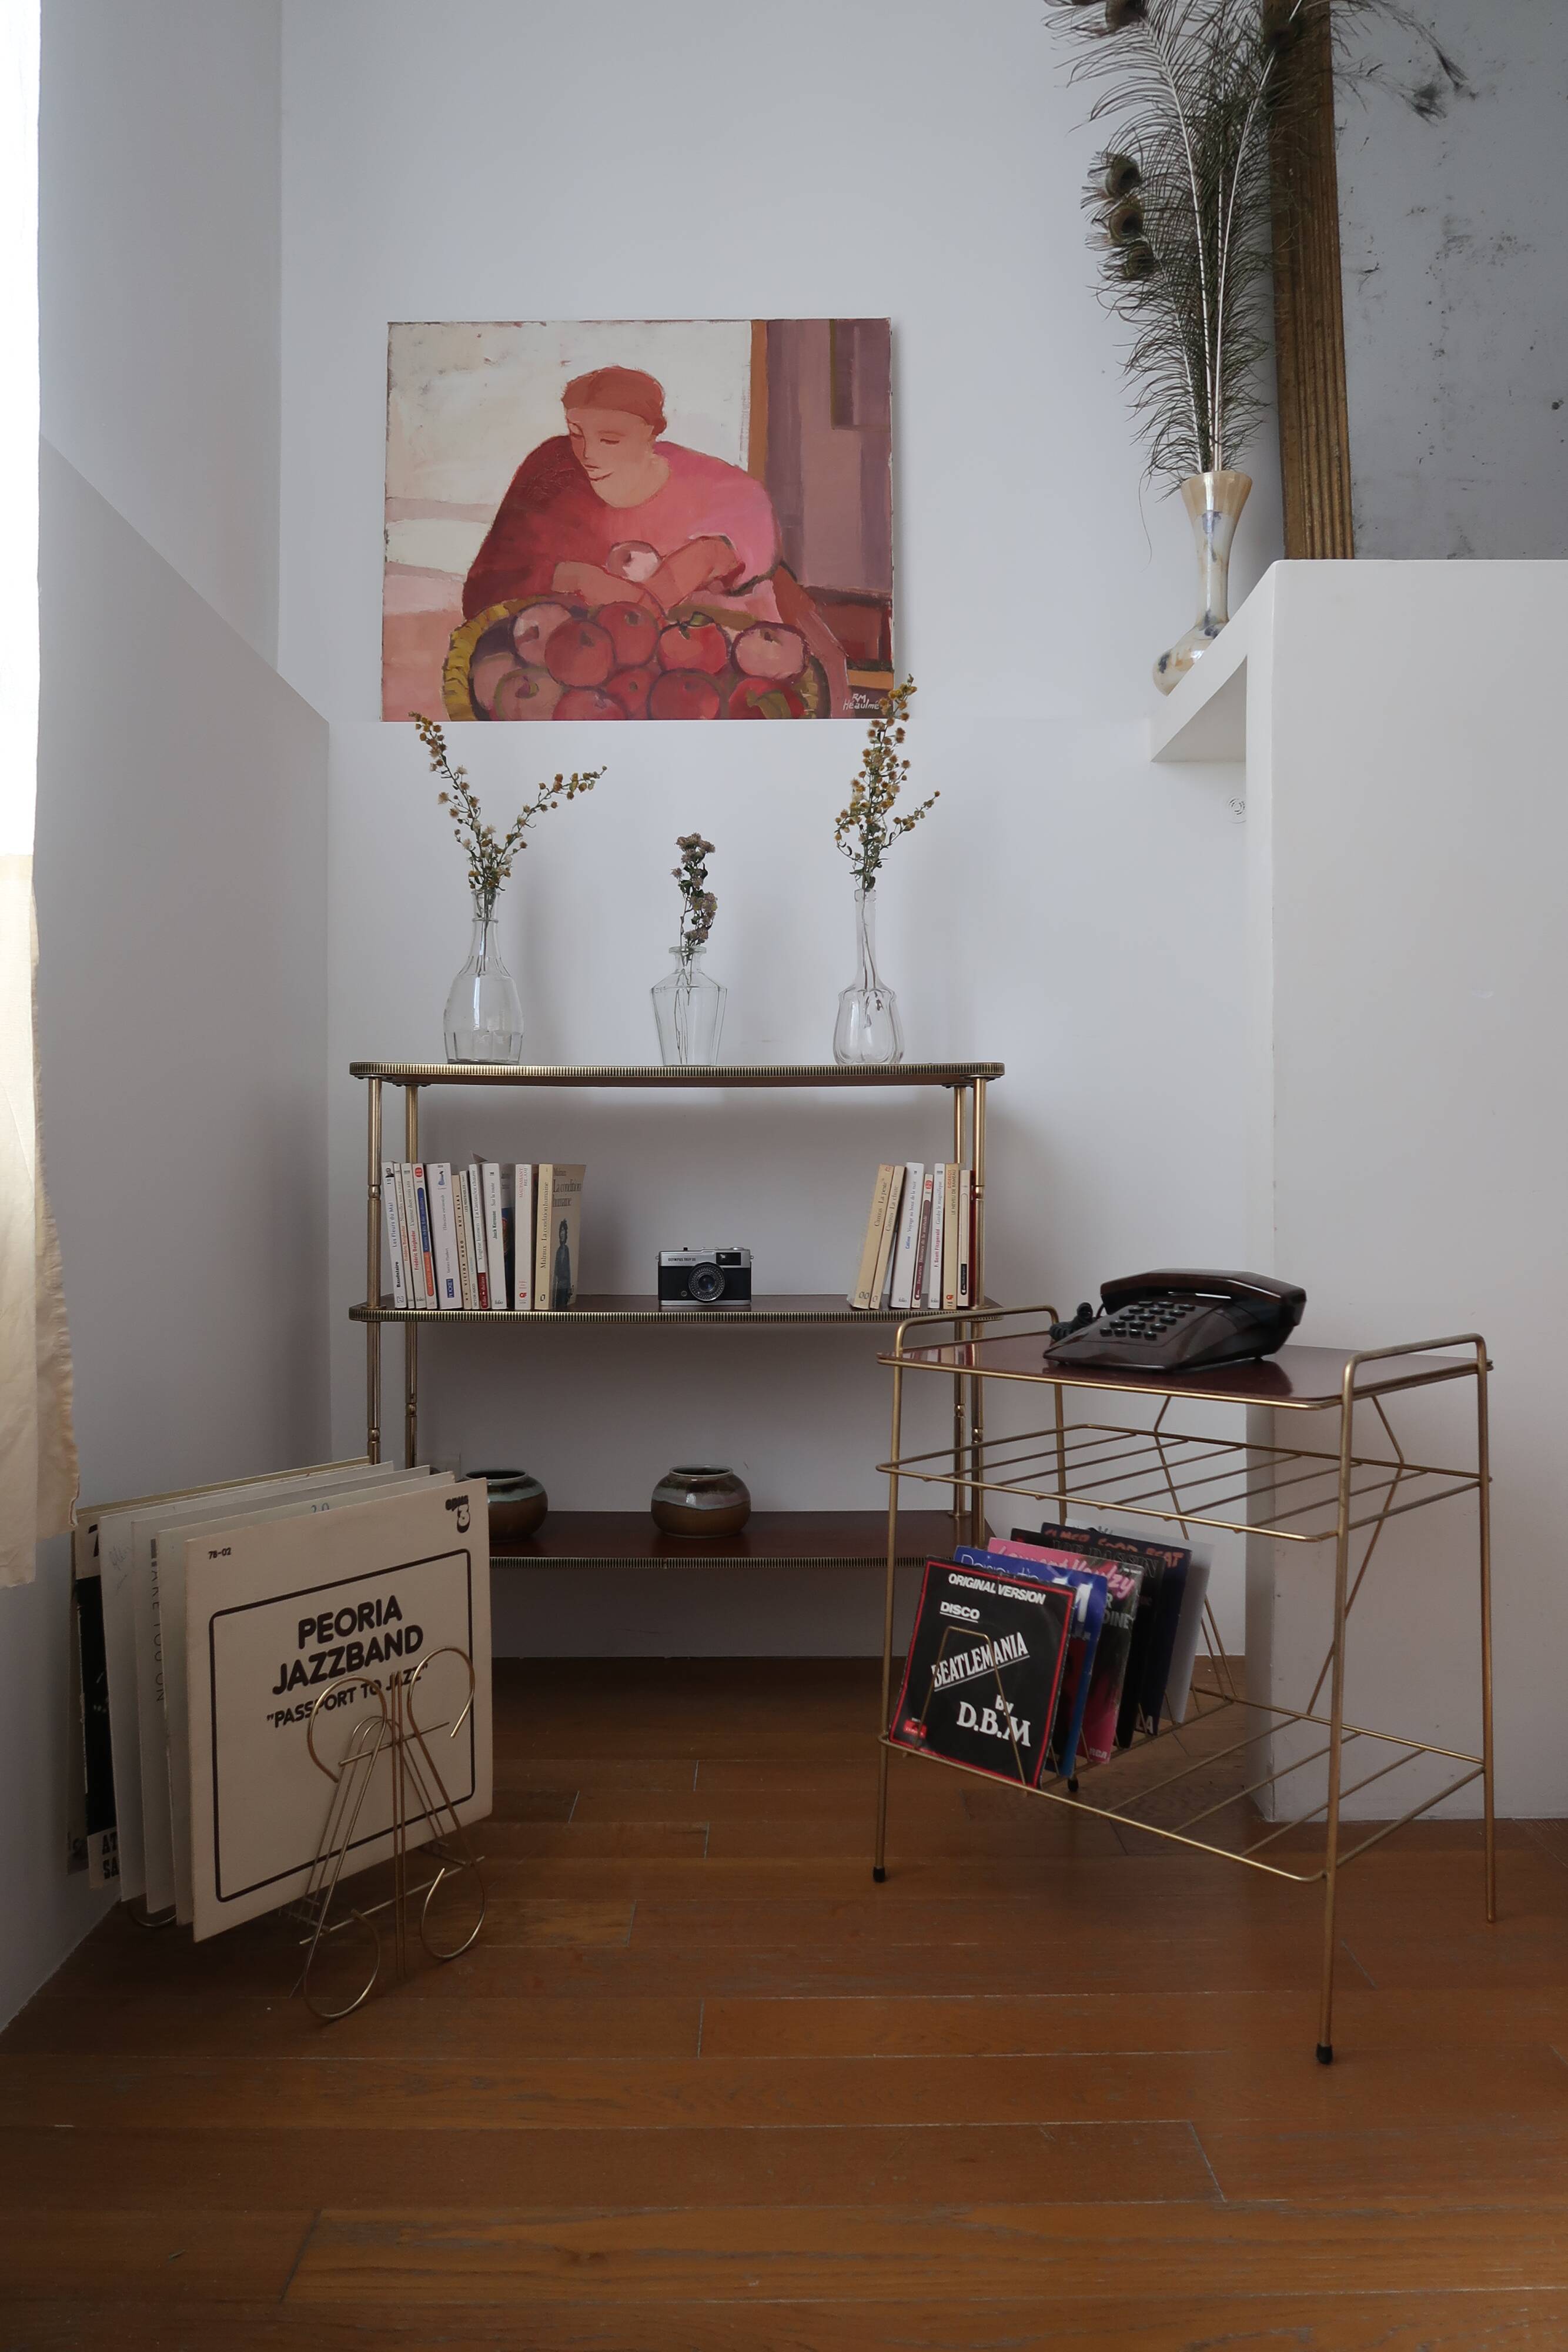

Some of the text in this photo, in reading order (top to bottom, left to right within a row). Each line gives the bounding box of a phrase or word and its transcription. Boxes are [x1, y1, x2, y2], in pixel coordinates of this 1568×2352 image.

[874, 1208, 883, 1227] Camus
[886, 1212, 894, 1231] Camus
[208, 1548, 232, 1560] 78-02
[948, 1572, 997, 1595] ORIGINAL
[997, 1584, 1047, 1605] VERSION
[940, 1601, 981, 1621] DISCO
[298, 1595, 403, 1649] PEORIA
[272, 1624, 424, 1695] JAZZBAND
[930, 1631, 1029, 1689] BEATLEMANIA
[360, 1679, 382, 1699] TO
[994, 1695, 1014, 1715] by
